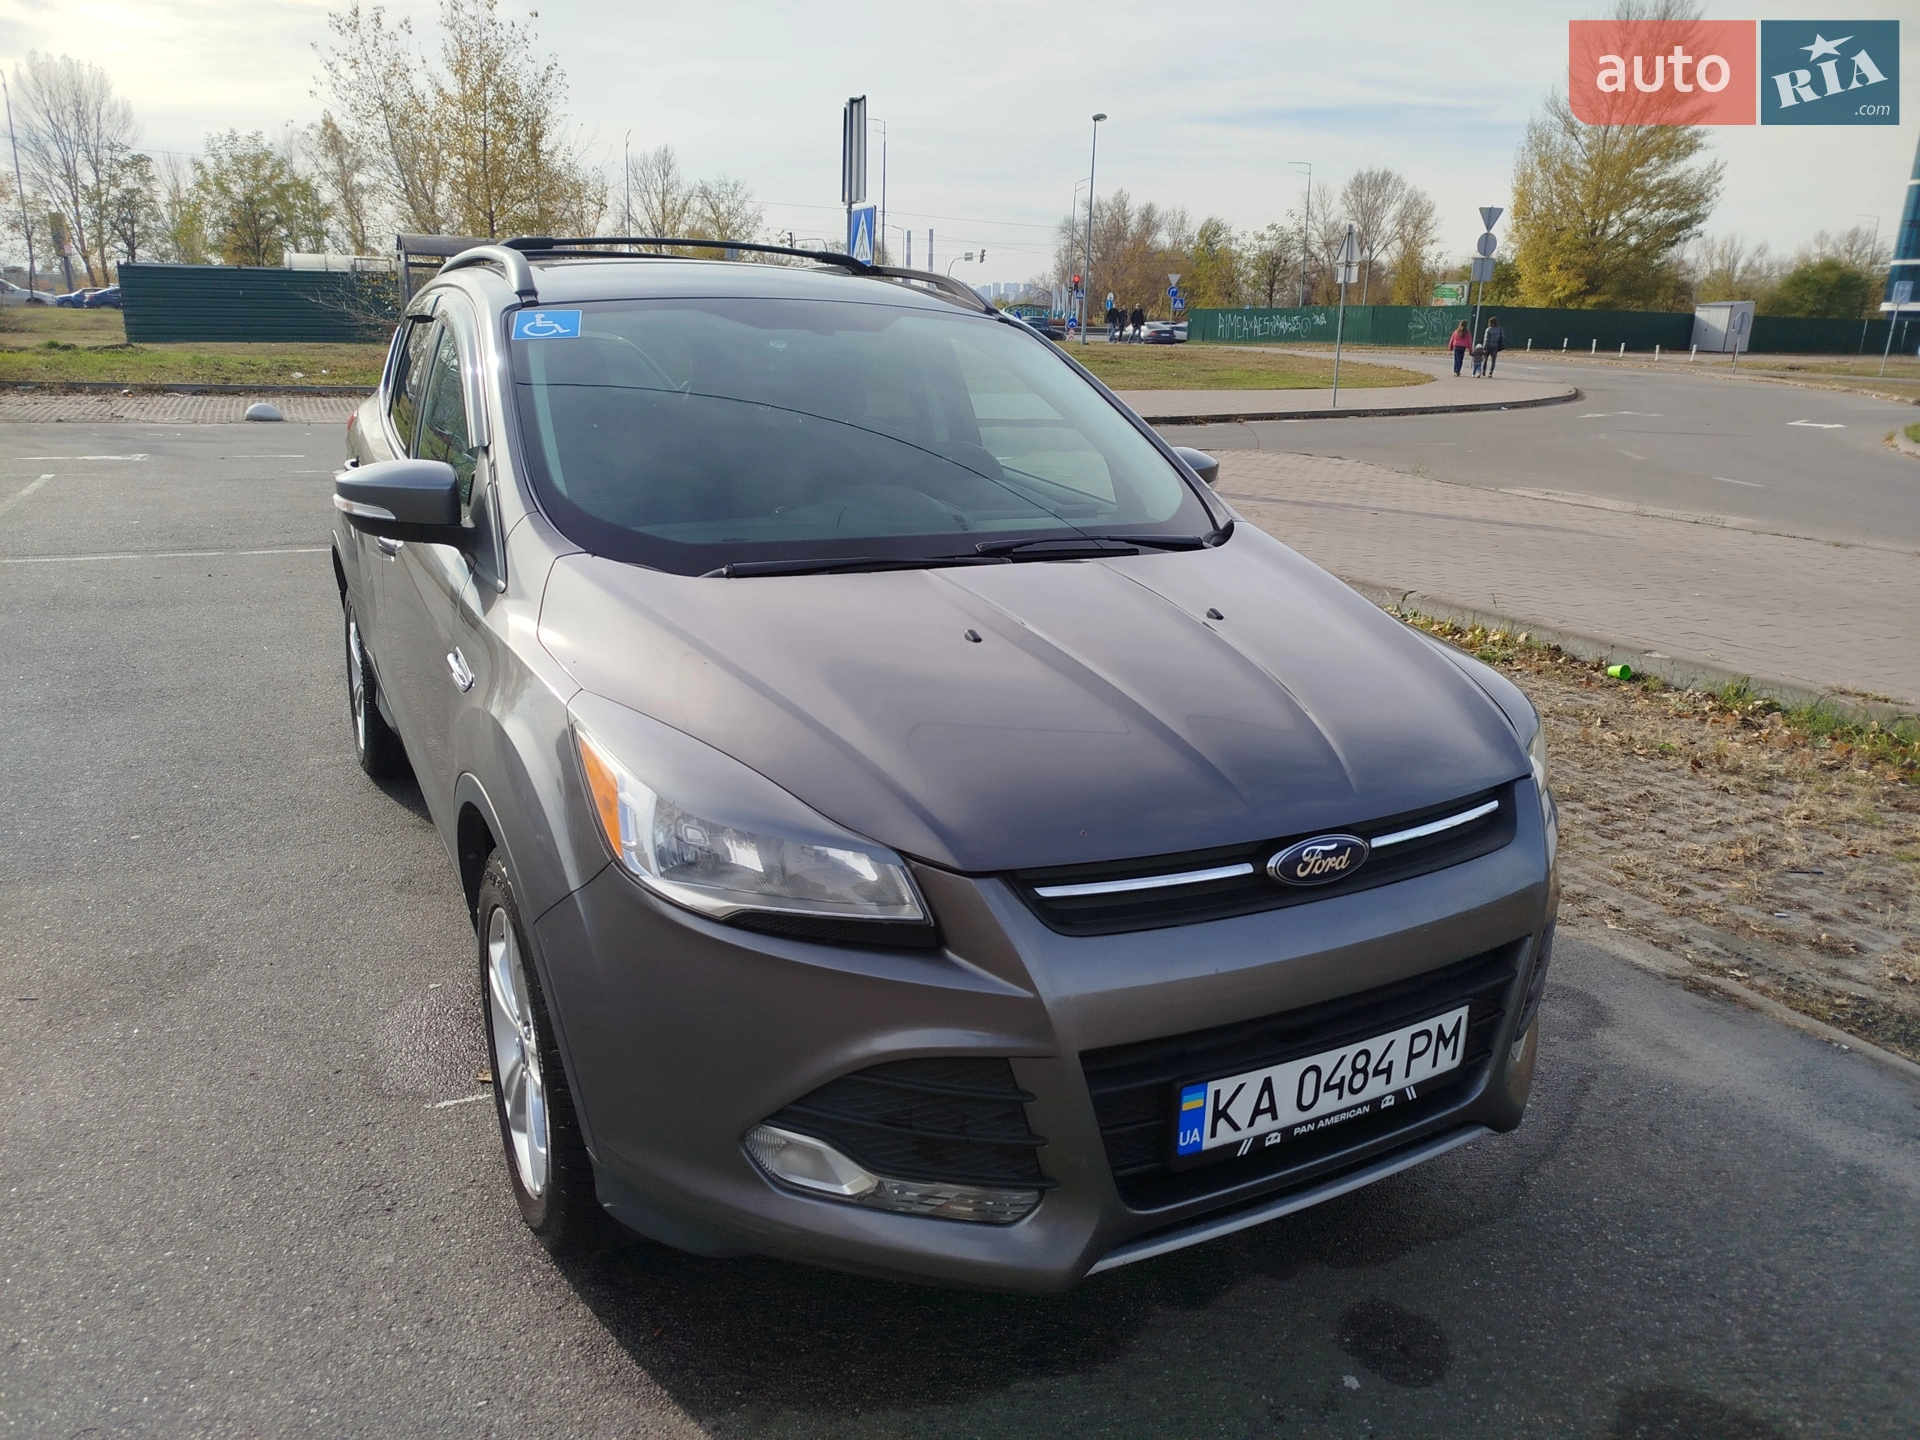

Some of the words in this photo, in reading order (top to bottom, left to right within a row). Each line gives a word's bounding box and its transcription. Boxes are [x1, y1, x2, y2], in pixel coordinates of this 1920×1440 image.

[1296, 842, 1351, 878] Ford
[1210, 1076, 1279, 1139] KA
[1295, 1039, 1396, 1112] 0484
[1404, 1015, 1463, 1079] PM
[1179, 1127, 1201, 1147] UA
[1293, 1122, 1315, 1136] PAN
[1317, 1104, 1370, 1129] AMERICAN
